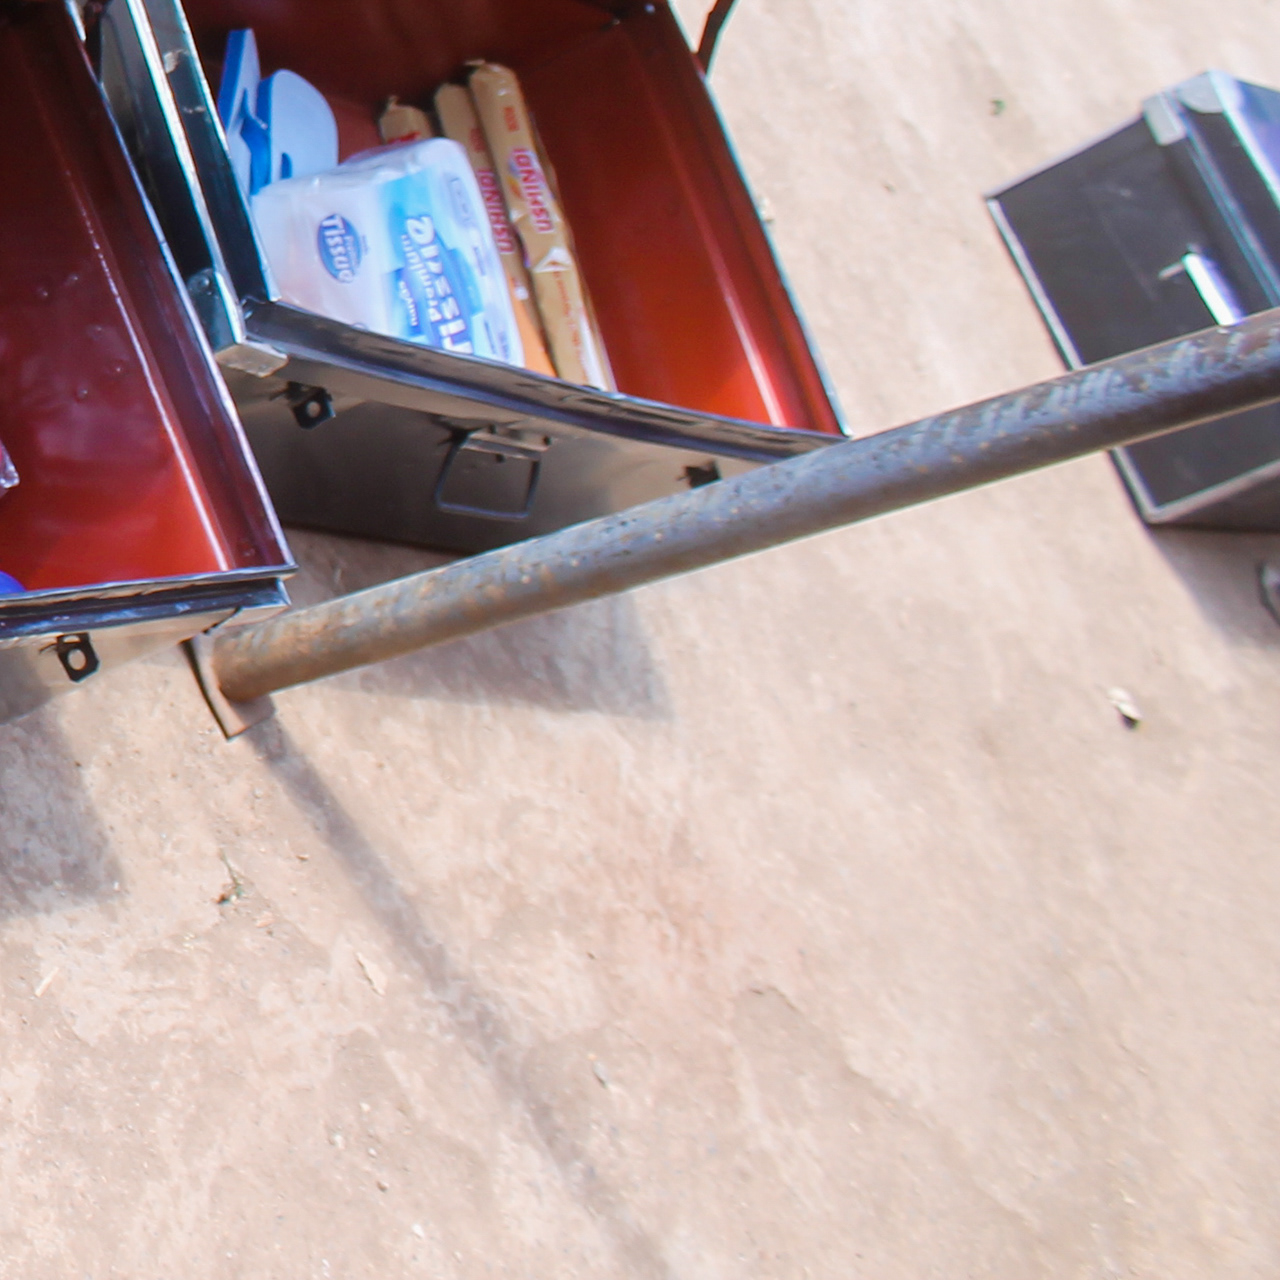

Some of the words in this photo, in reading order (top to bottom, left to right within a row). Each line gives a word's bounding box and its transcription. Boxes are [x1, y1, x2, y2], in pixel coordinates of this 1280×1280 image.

[476, 166, 514, 255] USHINDI
[513, 146, 555, 234] USHINDI
[318, 214, 353, 284] Tissue
